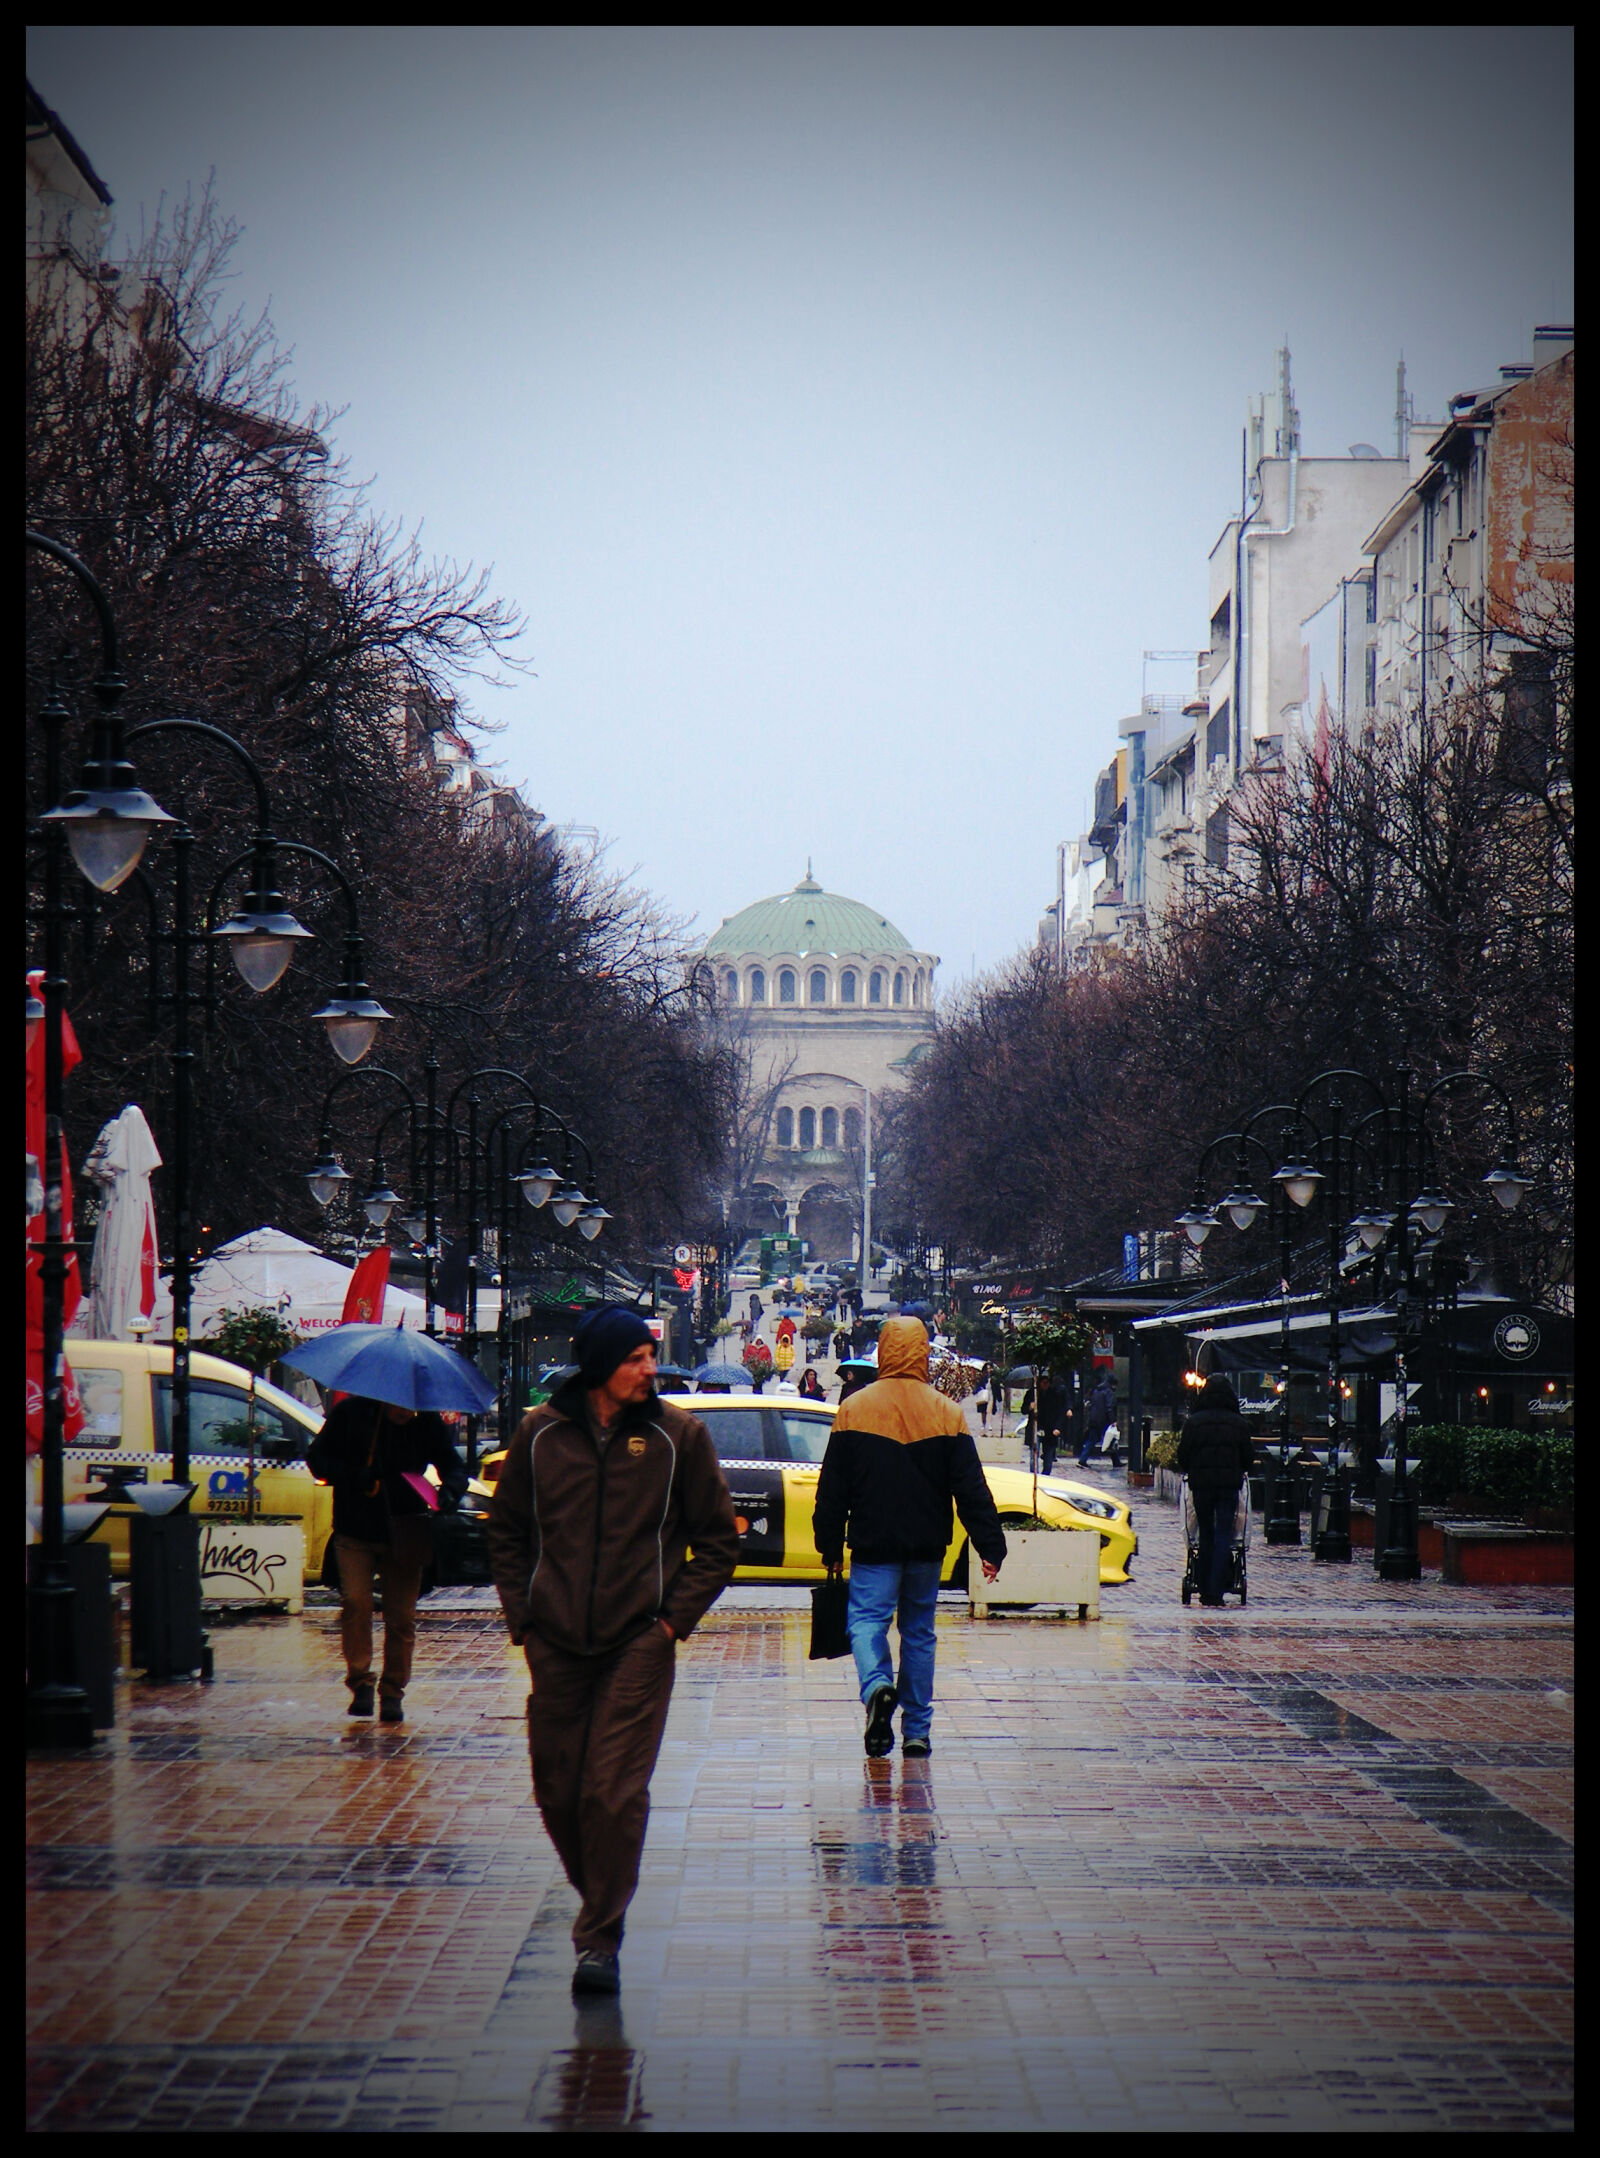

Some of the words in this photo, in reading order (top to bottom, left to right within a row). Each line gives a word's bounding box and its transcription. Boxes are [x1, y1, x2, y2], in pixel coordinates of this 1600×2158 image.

[972, 1284, 1003, 1294] BINGO
[299, 1317, 342, 1328] WELCO
[1238, 1398, 1282, 1412] Davidoff
[1528, 1399, 1574, 1413] Davidoff
[208, 1500, 261, 1512] 973211
